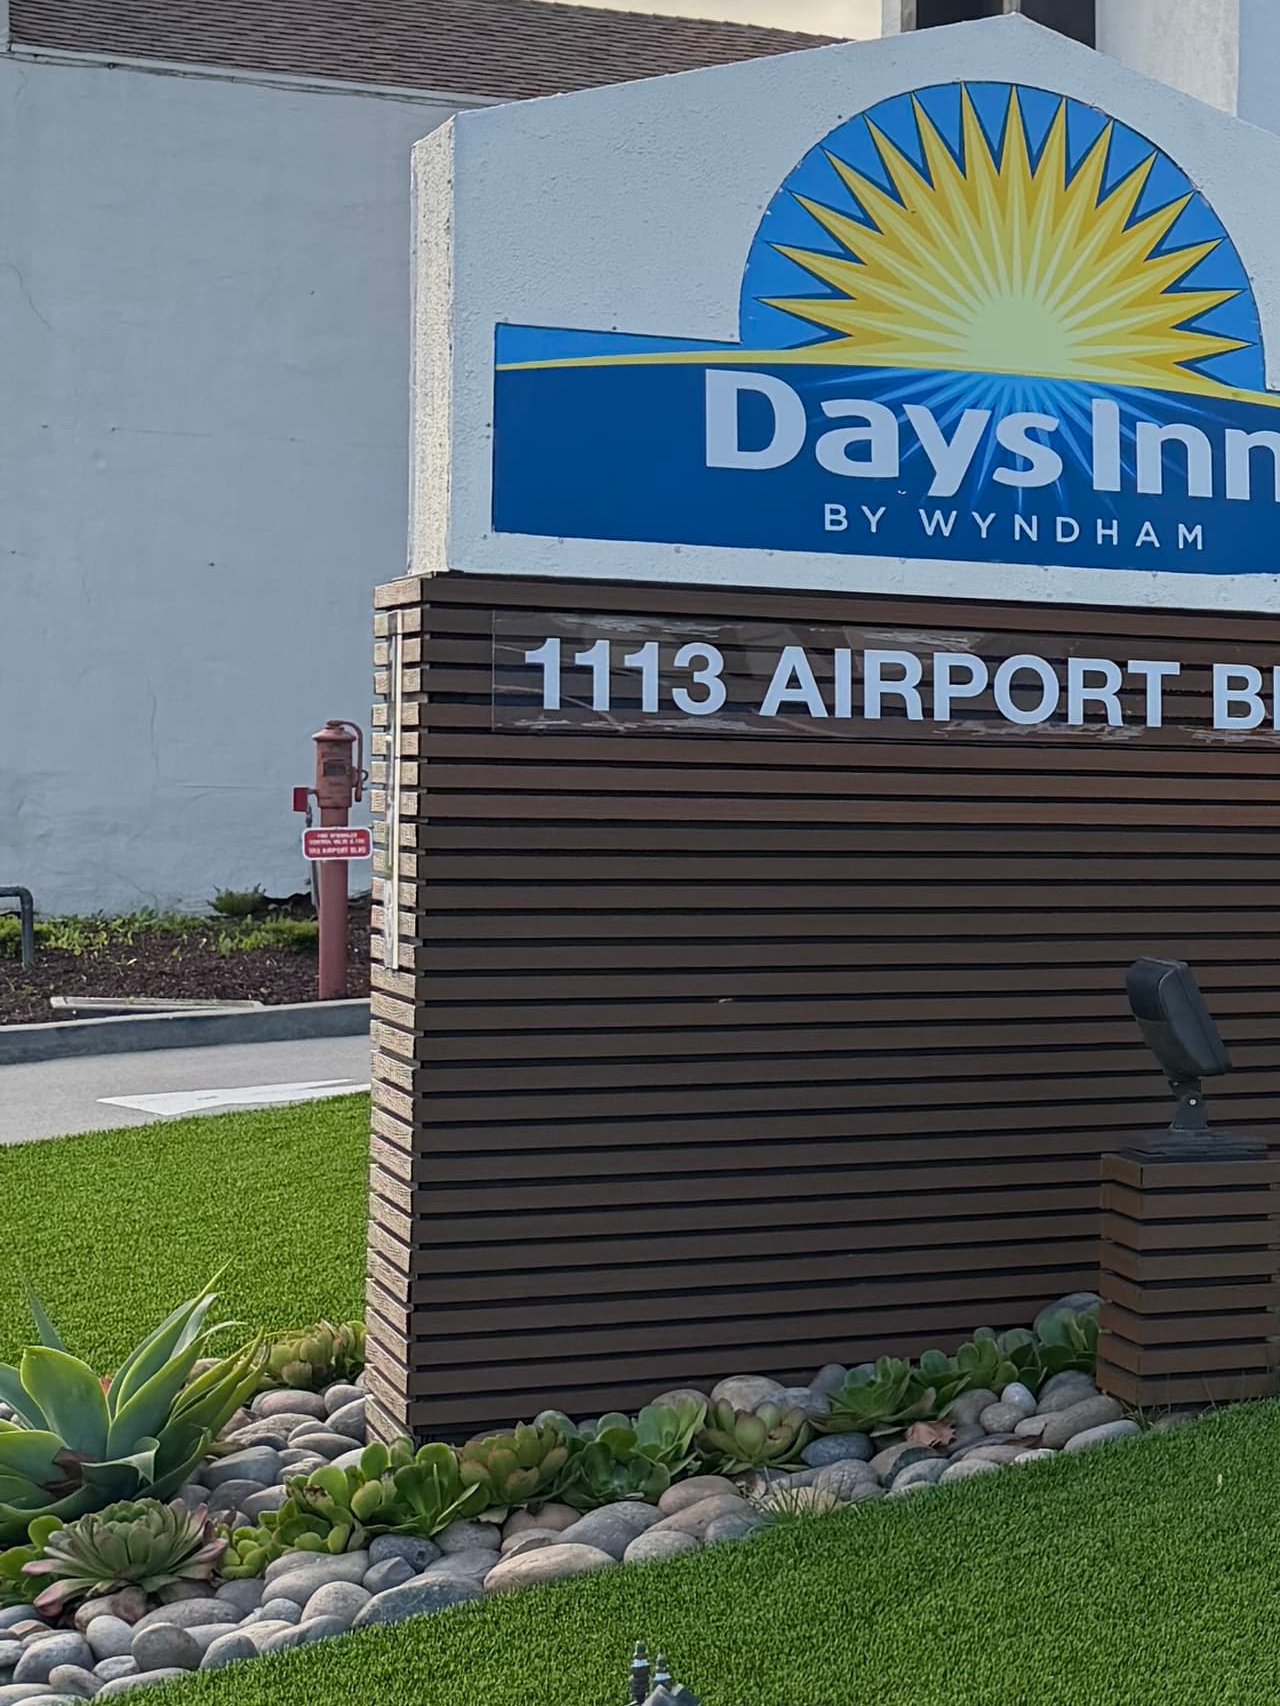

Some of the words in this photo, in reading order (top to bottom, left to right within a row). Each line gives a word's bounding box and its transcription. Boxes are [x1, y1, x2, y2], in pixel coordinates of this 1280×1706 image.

[706, 369, 1062, 497] Days
[824, 503, 887, 533] BY
[919, 508, 1205, 550] WYNDHAM
[525, 637, 727, 715] 1113
[758, 645, 1181, 728] AIRPORT
